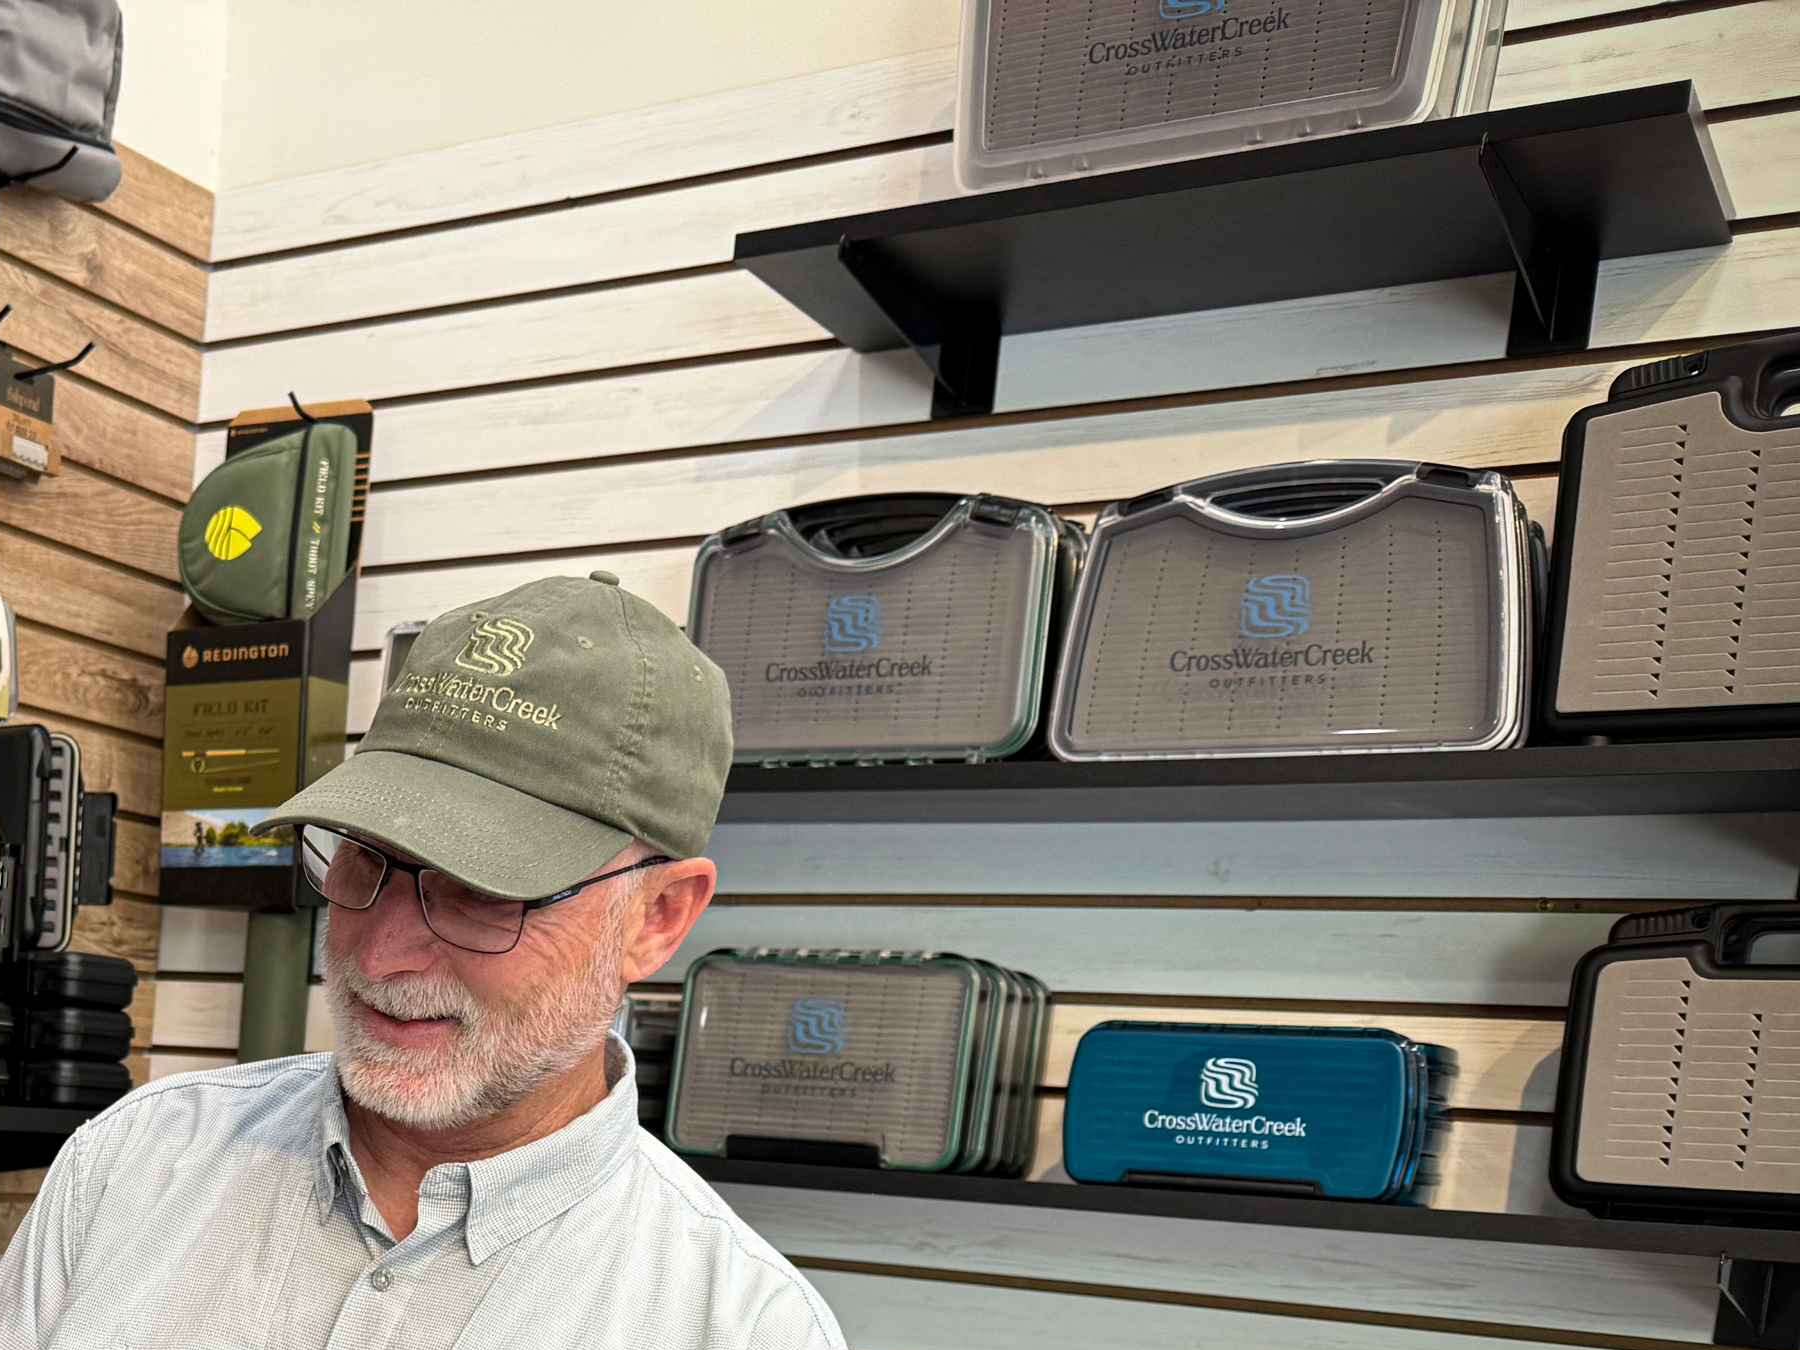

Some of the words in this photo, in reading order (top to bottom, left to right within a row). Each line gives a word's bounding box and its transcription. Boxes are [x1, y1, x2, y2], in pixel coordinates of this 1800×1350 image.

[1088, 8, 1292, 67] CrossWaterCreek
[1126, 45, 1246, 76] OUTFITTERS
[202, 643, 290, 665] REDINGTON
[765, 653, 933, 684] CrossWaterCreek
[1169, 639, 1376, 673] CrossWaterCreek
[797, 683, 899, 698] OUTFITTERS
[1208, 673, 1328, 690] OUTFITTERS
[404, 696, 509, 732] OUTFITTERS
[727, 1055, 896, 1086] CrossWaterCreek
[1142, 1107, 1308, 1140] CrossWaterCreek
[1174, 1135, 1271, 1152] OUTFITTERS
